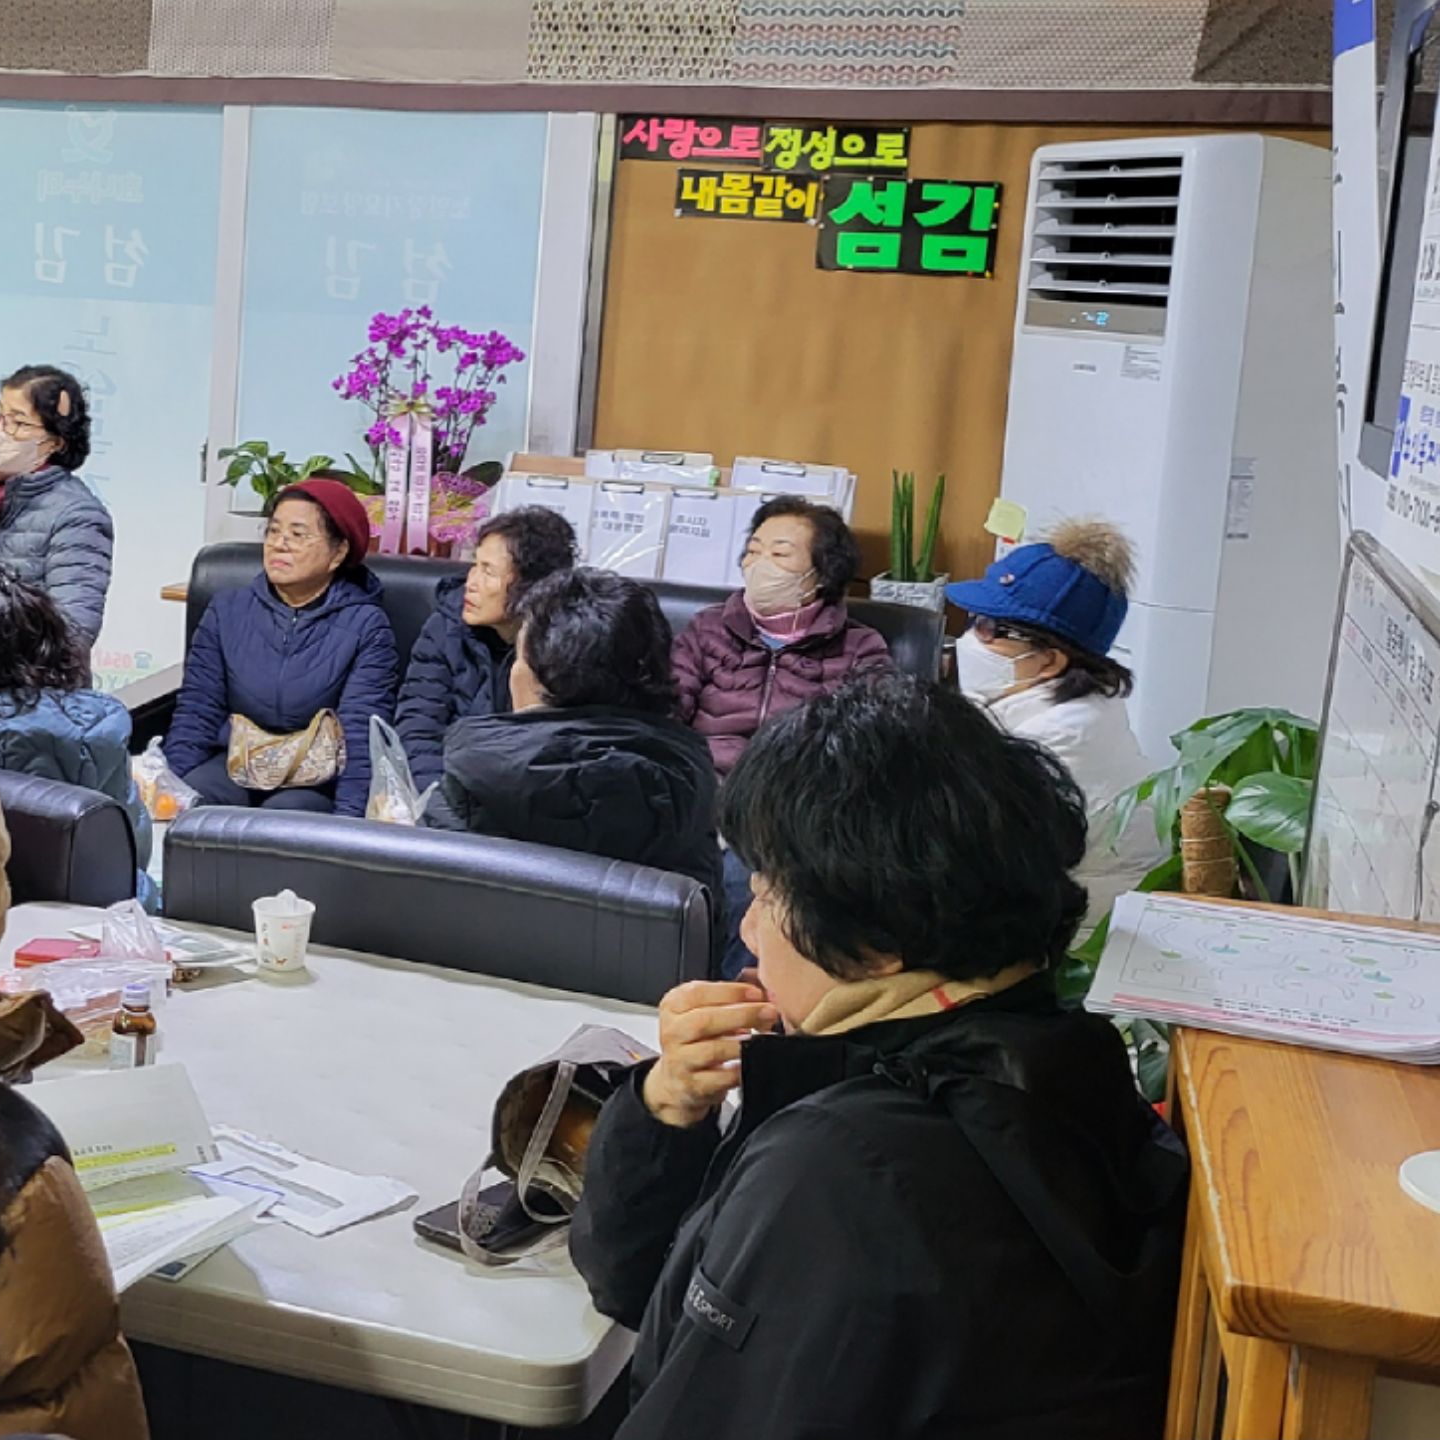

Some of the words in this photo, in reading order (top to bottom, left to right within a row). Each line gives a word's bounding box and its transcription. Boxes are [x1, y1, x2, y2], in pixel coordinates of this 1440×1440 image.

[623, 118, 761, 160] 사랑으로
[764, 124, 909, 170] 정성으로
[681, 172, 818, 218] 내몸같이
[828, 180, 997, 272] 섬김
